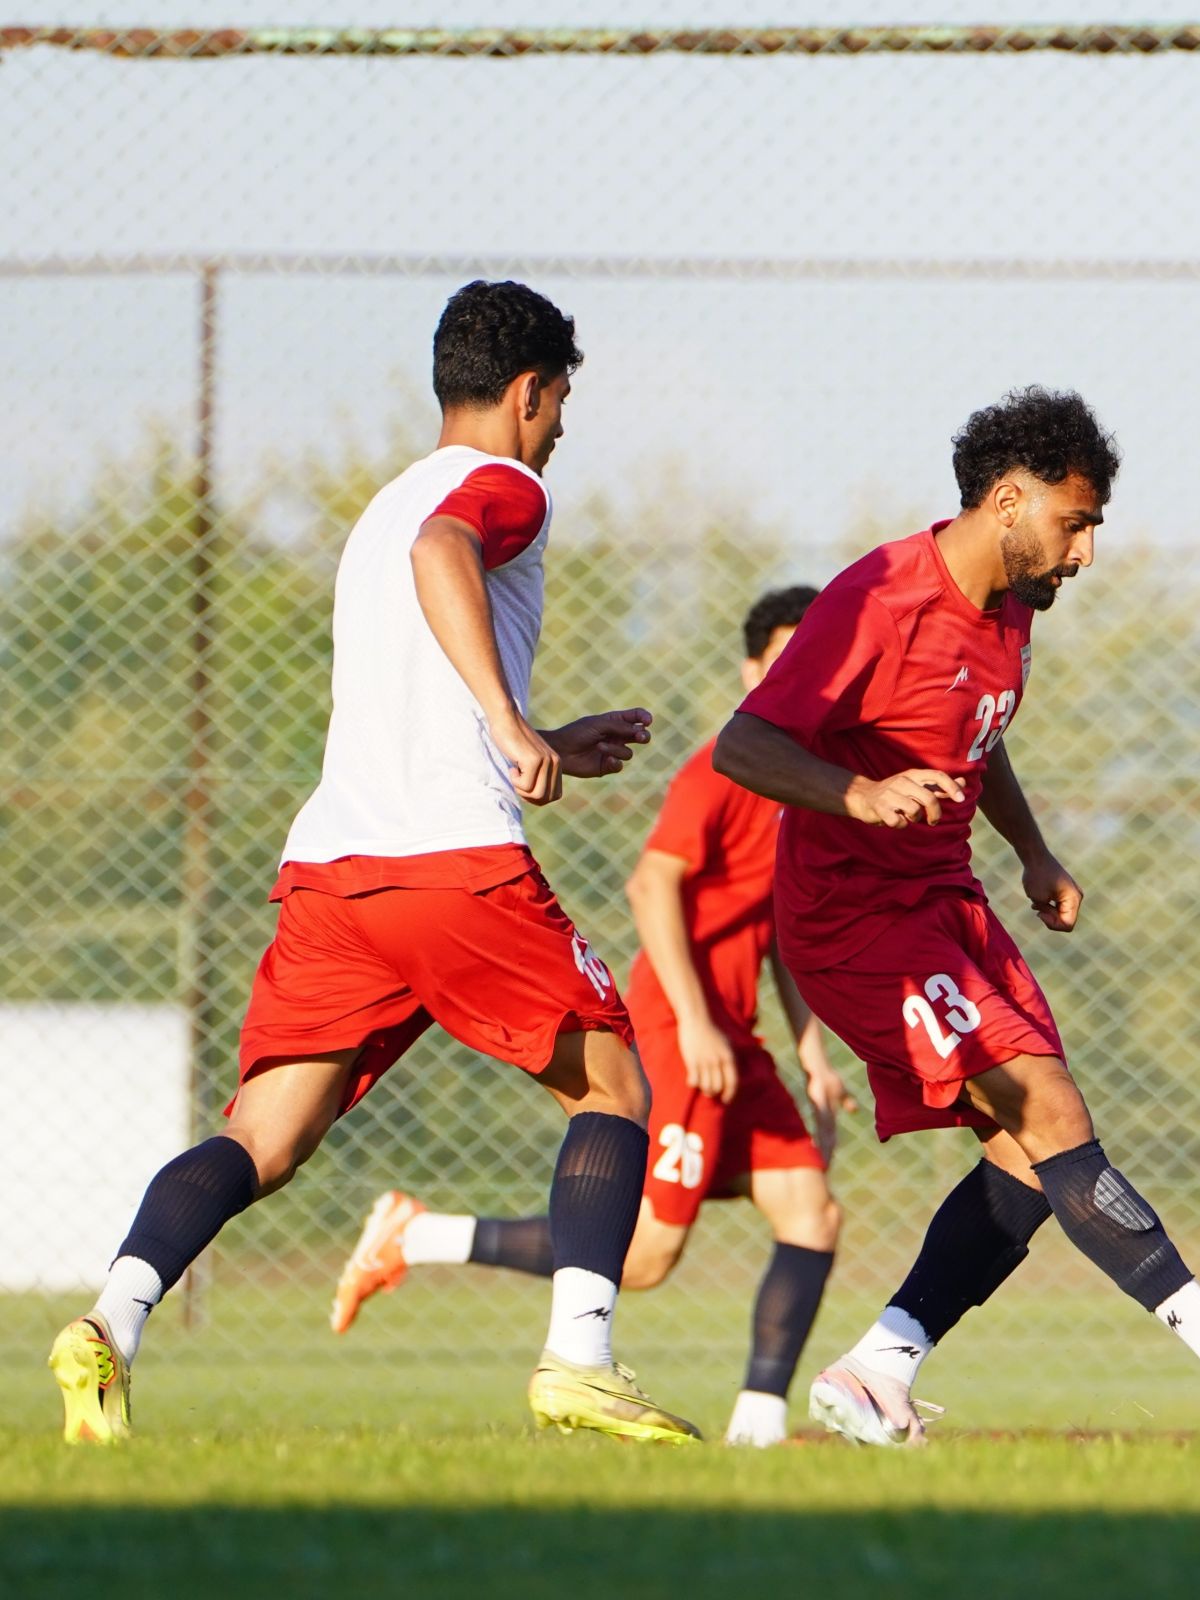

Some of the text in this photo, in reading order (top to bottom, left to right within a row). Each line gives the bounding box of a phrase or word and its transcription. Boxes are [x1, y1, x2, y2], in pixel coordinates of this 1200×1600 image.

[966, 689, 1016, 763] 23
[902, 973, 982, 1060] 23
[653, 1122, 704, 1189] 26
